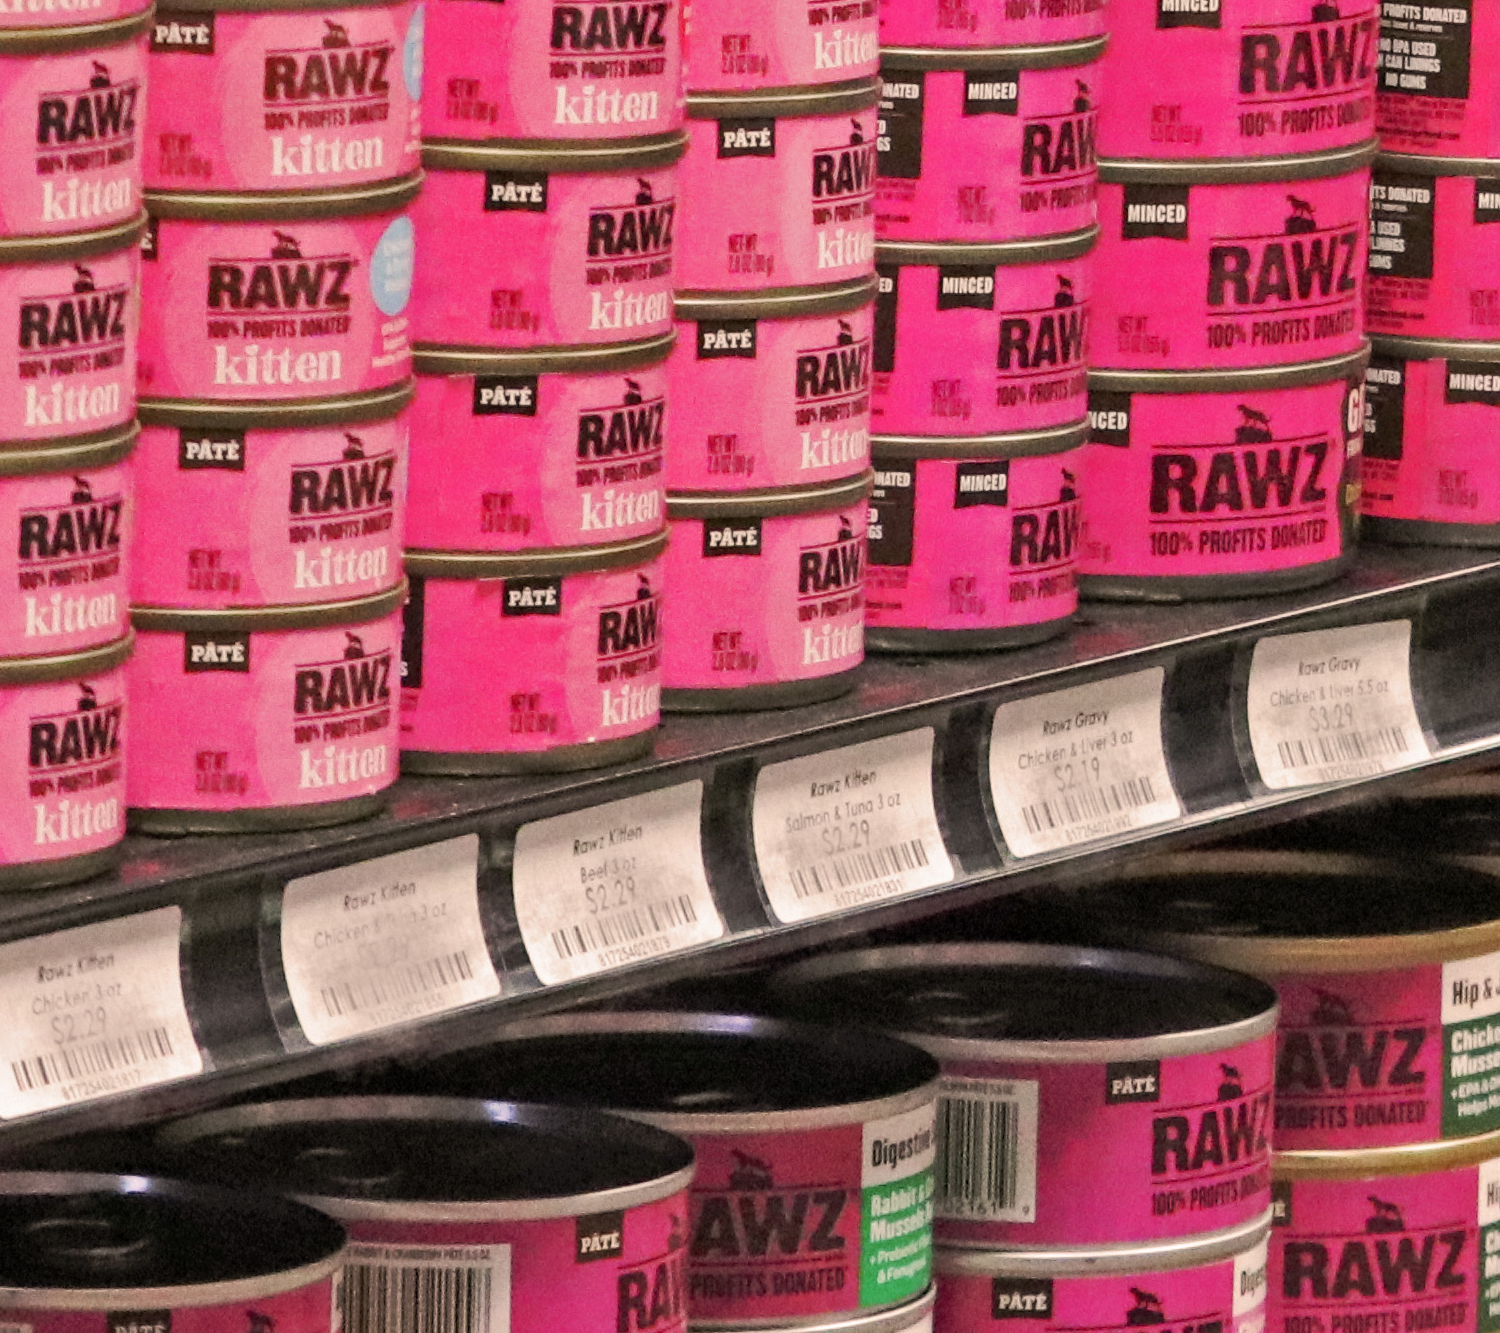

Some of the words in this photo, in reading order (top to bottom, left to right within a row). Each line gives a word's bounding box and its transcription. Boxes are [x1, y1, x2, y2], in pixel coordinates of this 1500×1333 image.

[1383, 3, 1421, 19] PROFITS
[1423, 6, 1467, 23] DONATED
[1150, 443, 1329, 515] RAWZ
[1042, 716, 1074, 736] Rawz
[1076, 707, 1109, 731] Gravy
[1017, 744, 1067, 770] Chicken
[1080, 735, 1108, 755] Liver
[1120, 731, 1133, 745] oz
[809, 775, 840, 798] Rawz
[843, 768, 877, 791] Kitten
[1055, 755, 1102, 793] $2.19
[785, 809, 831, 833] Salmon
[844, 799, 875, 822] Tuna
[887, 795, 901, 811] oz
[585, 876, 637, 915] $2.29
[1453, 980, 1478, 1009] Hip
[1483, 978, 1492, 999] &
[50, 1006, 107, 1046] $2.29
[1110, 1073, 1156, 1096] PÂTÉ
[1282, 1229, 1468, 1299] RAWZ
